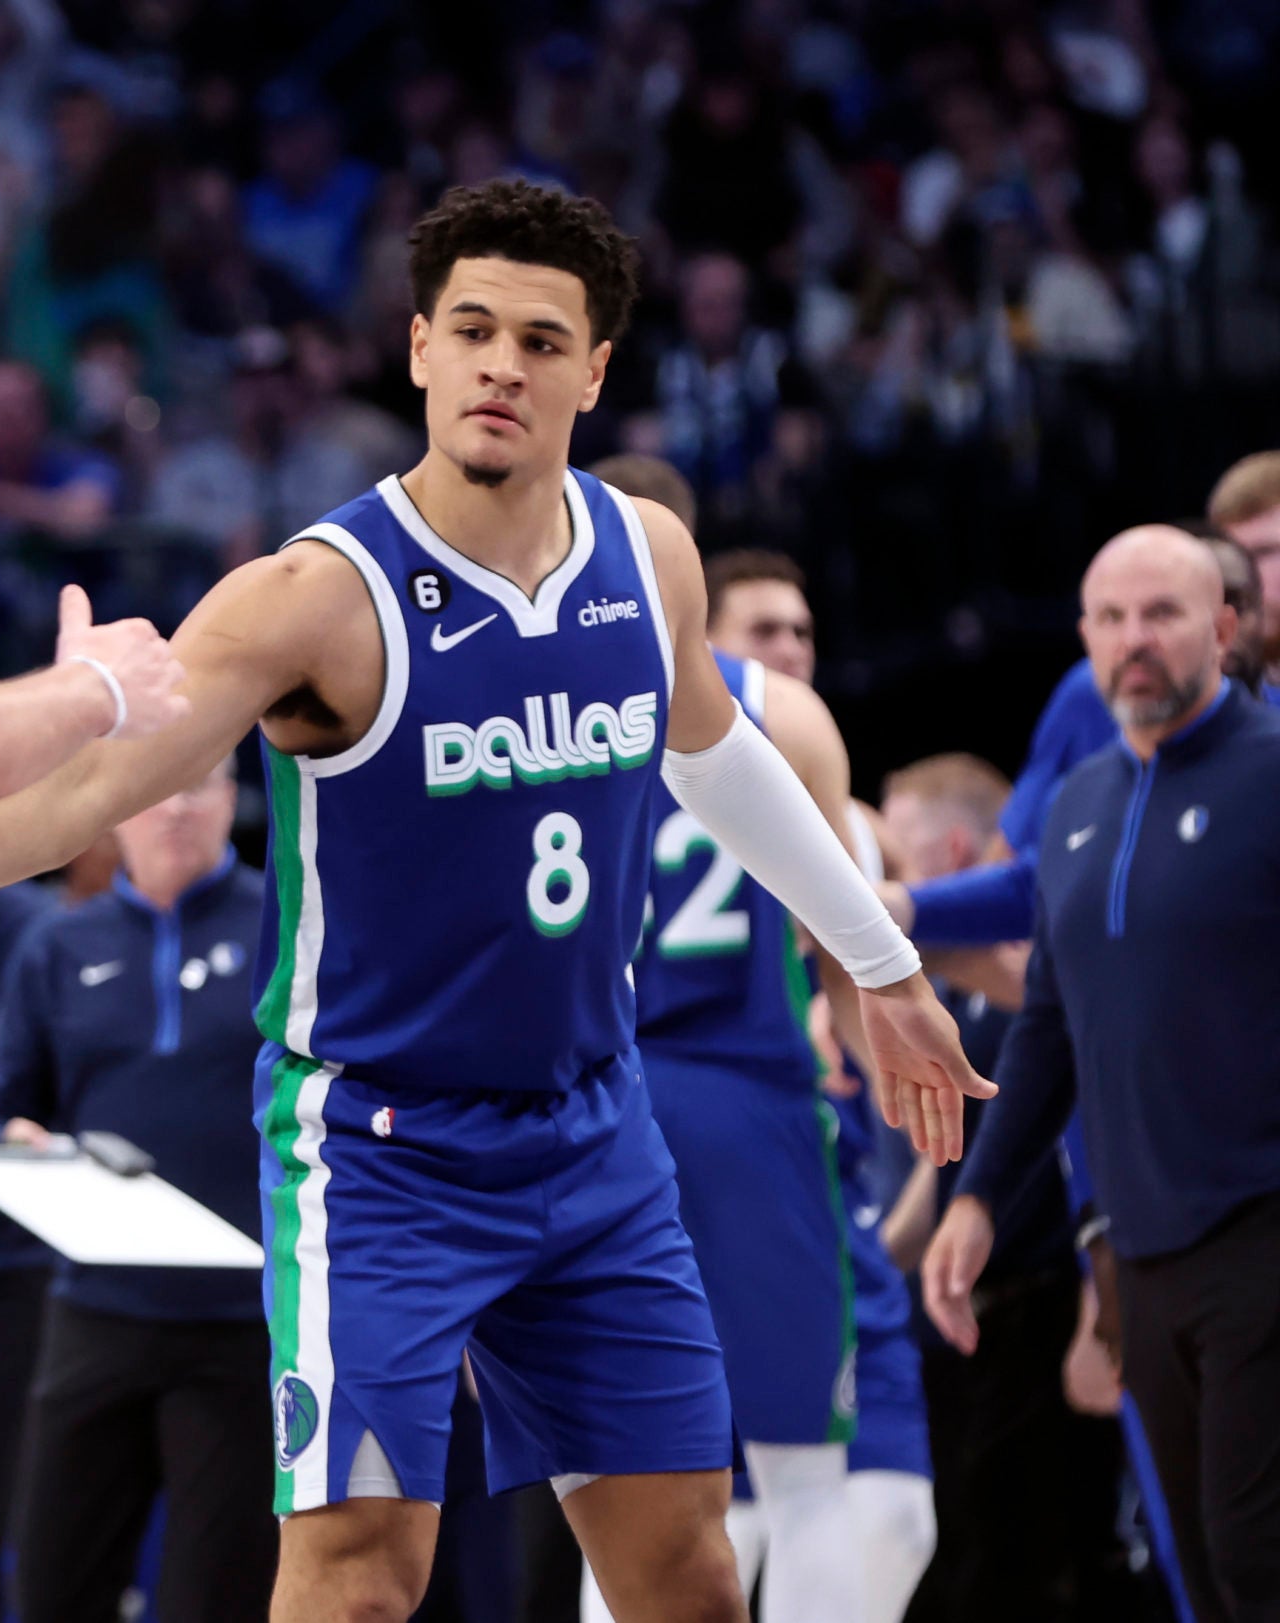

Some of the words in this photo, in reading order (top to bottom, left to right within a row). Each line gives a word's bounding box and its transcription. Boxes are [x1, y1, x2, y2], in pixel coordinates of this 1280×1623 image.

[414, 574, 442, 610] 6
[578, 598, 640, 627] chime
[527, 811, 590, 938] 8
[634, 809, 751, 960] 2
